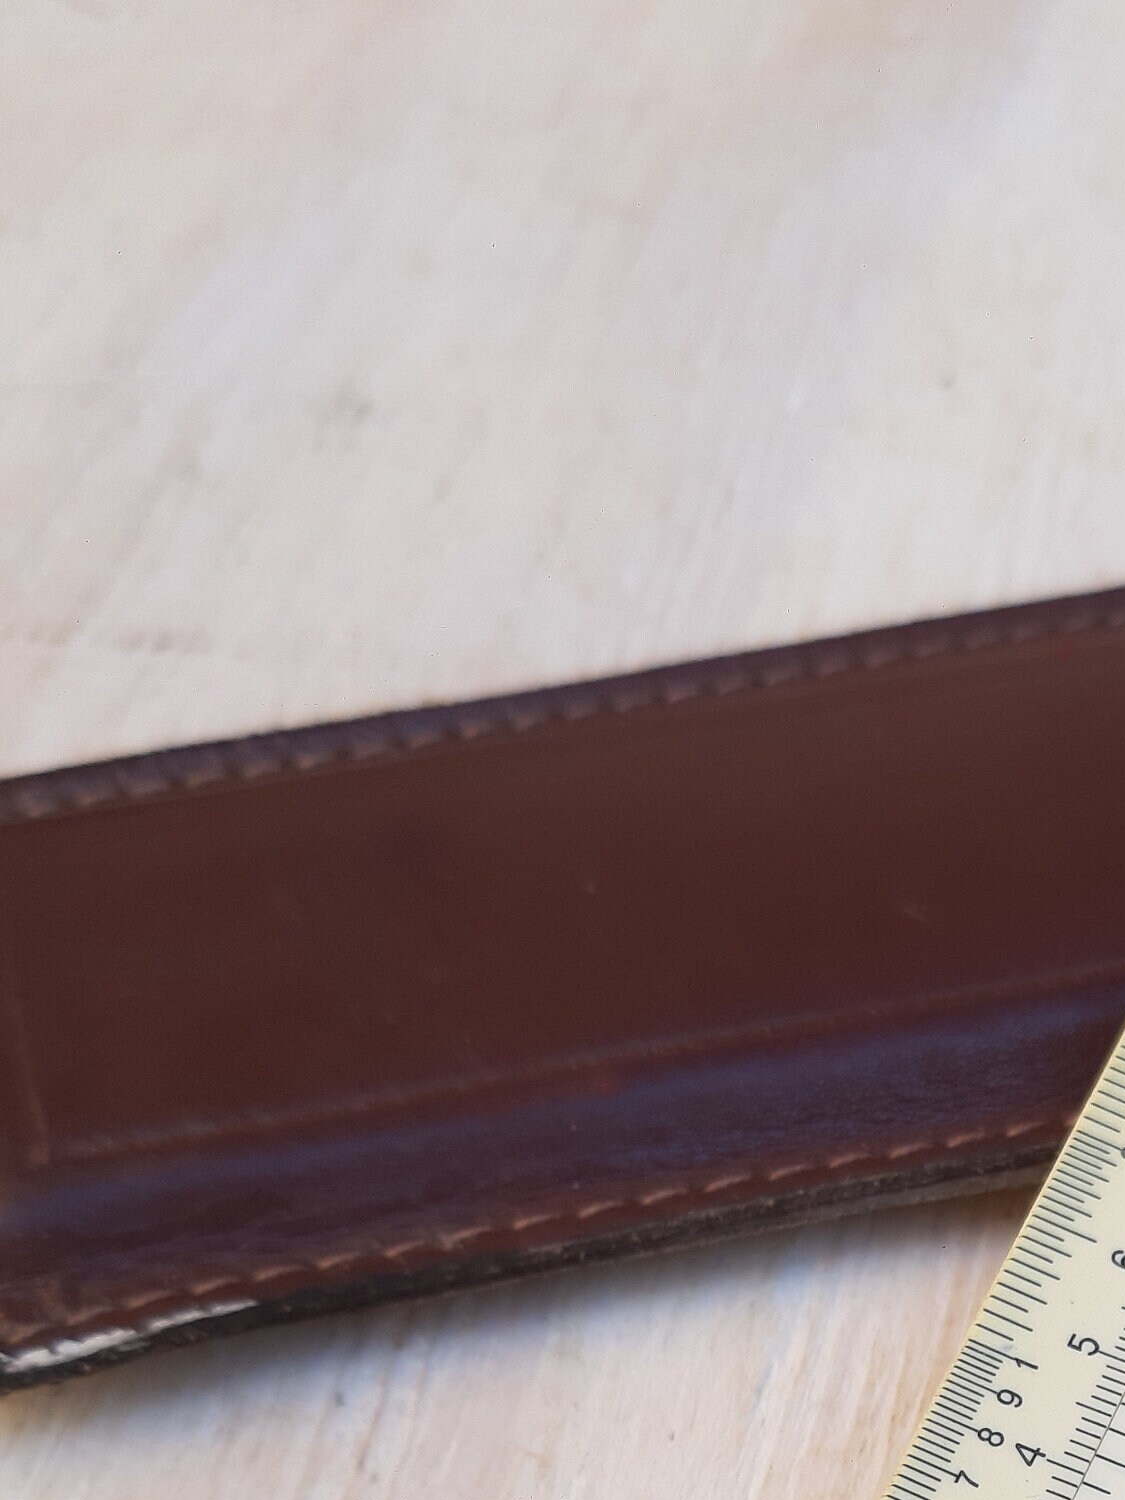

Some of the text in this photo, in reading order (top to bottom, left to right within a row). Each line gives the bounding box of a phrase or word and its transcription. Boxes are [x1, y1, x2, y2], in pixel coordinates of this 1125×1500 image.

[1067, 1334, 1100, 1356] 5
[997, 1389, 1023, 1408] 9
[977, 1427, 1005, 1447] 8
[1015, 1443, 1046, 1467] 4
[954, 1470, 979, 1488] 7
